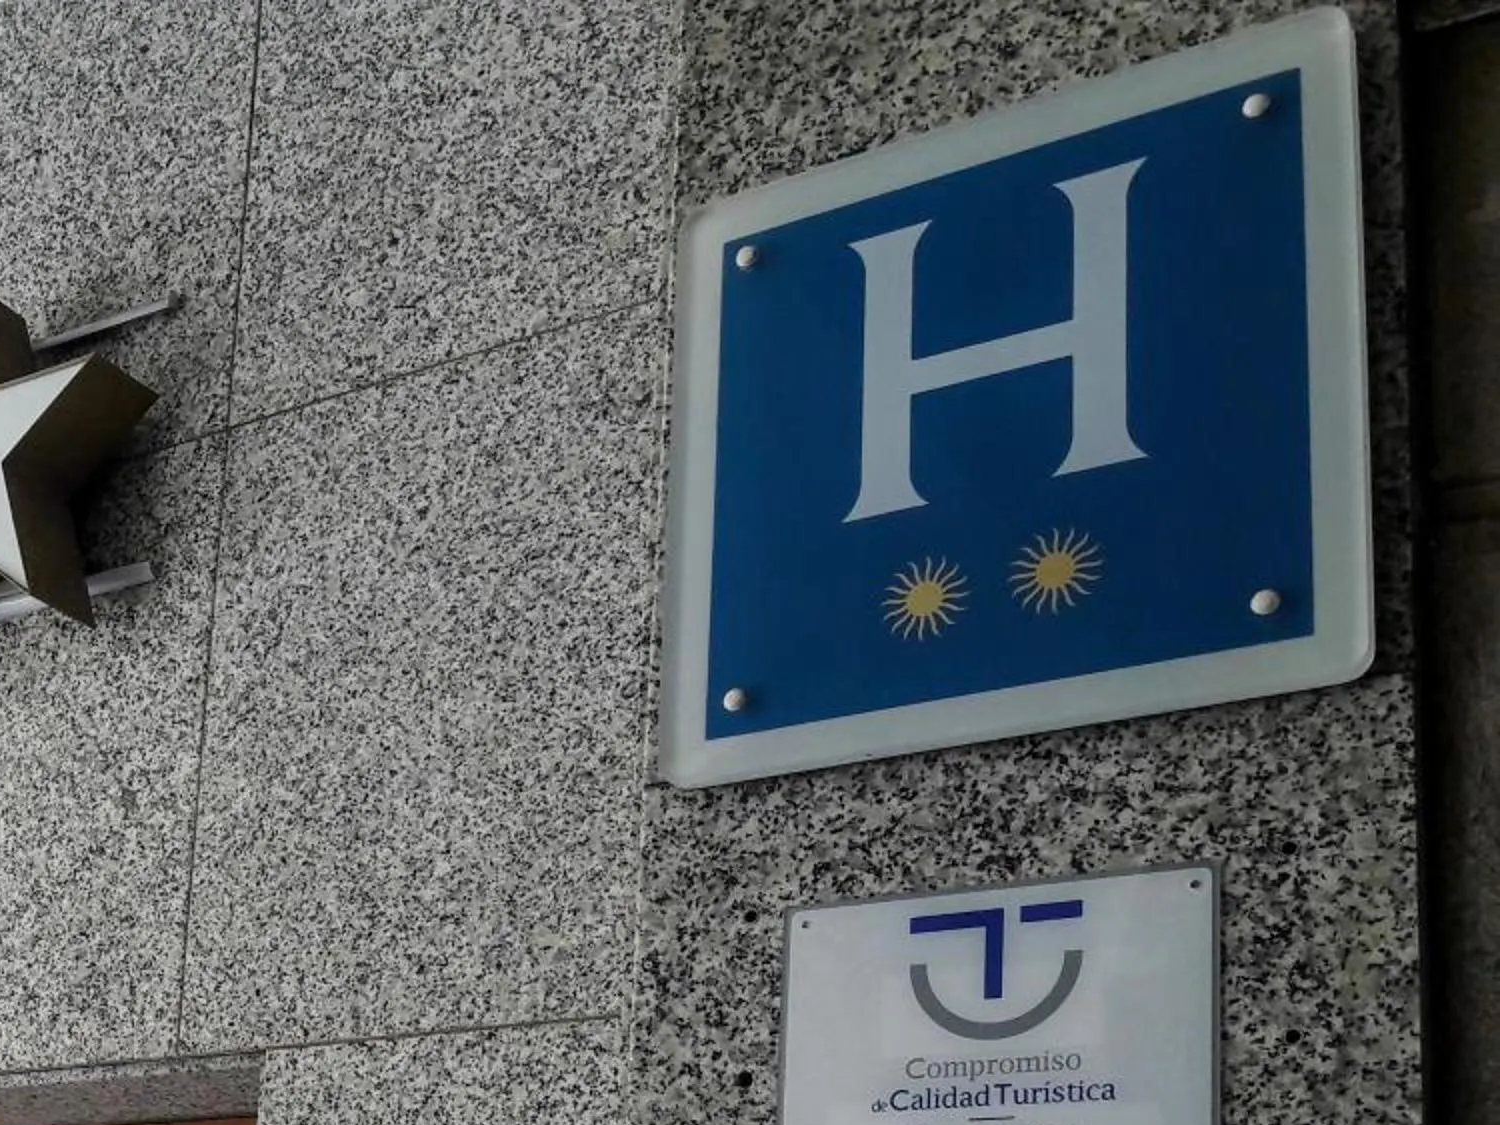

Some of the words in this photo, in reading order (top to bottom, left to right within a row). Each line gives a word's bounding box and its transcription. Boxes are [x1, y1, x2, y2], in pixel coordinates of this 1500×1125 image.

[842, 156, 1153, 524] H
[905, 1050, 1082, 1081] Compromiso
[870, 1100, 888, 1113] de
[889, 1084, 991, 1111] Calidad
[993, 1079, 1117, 1105] Turística
